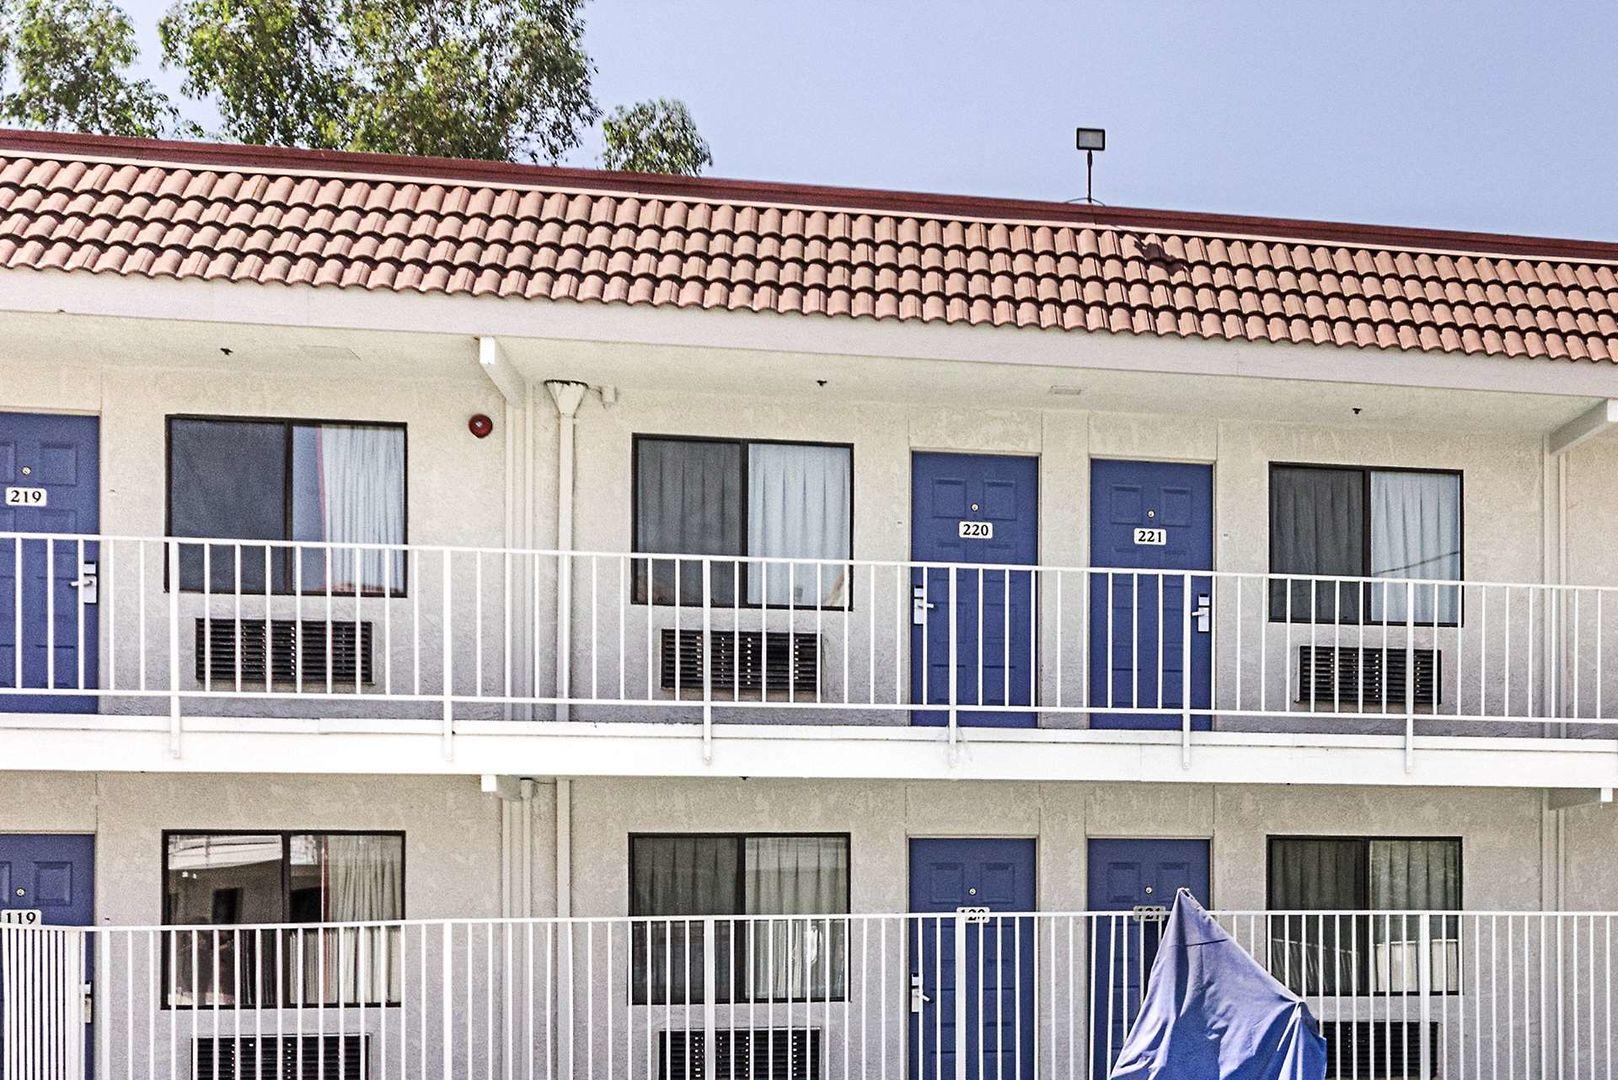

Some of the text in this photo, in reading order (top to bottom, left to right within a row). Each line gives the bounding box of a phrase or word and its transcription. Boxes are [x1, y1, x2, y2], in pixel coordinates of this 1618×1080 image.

[11, 490, 42, 503] 219
[963, 524, 989, 536] 220
[1138, 530, 1162, 543] 221
[6, 912, 36, 925] 119
